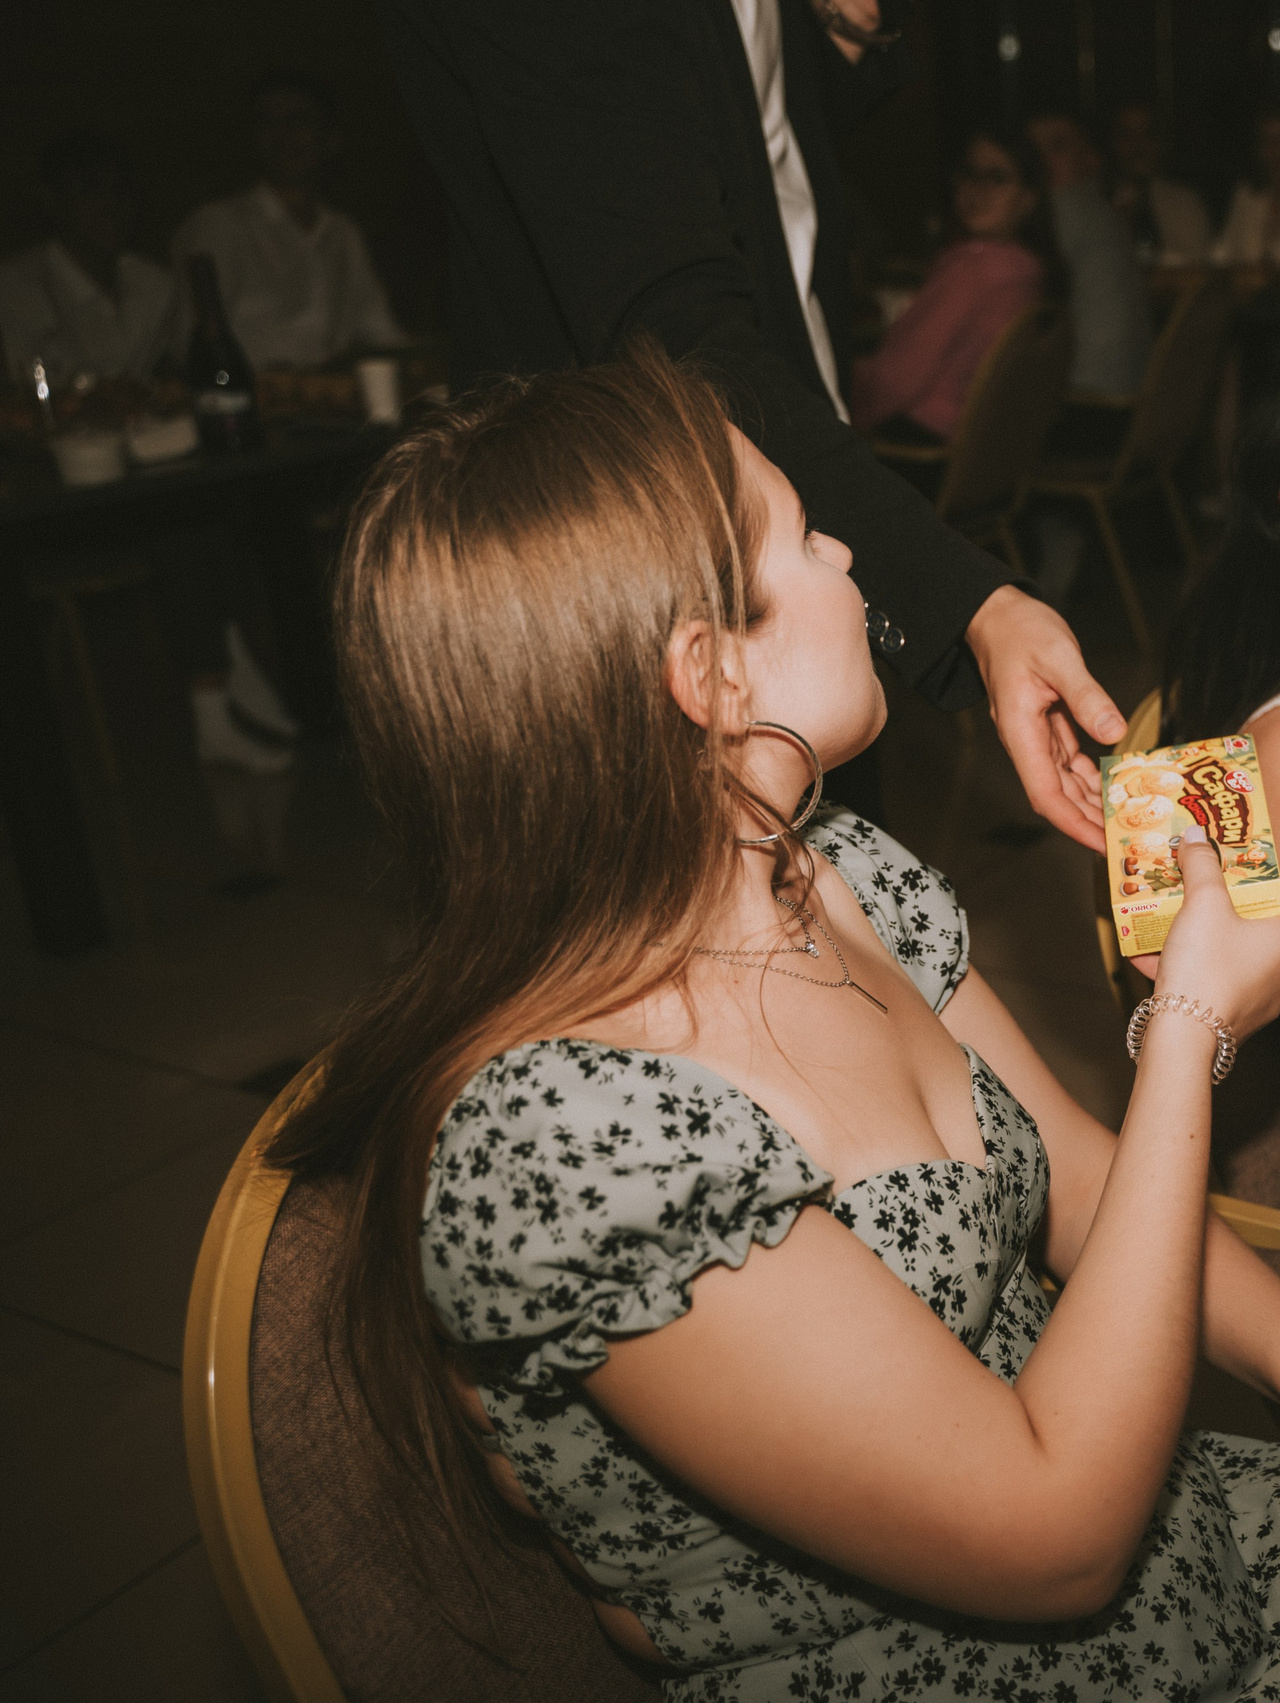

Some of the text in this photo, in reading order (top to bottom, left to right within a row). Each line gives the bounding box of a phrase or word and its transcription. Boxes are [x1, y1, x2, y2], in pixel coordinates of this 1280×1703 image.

[1179, 795, 1209, 827] банан
[1192, 765, 1243, 842] Сафари
[1131, 903, 1158, 912] ORION
